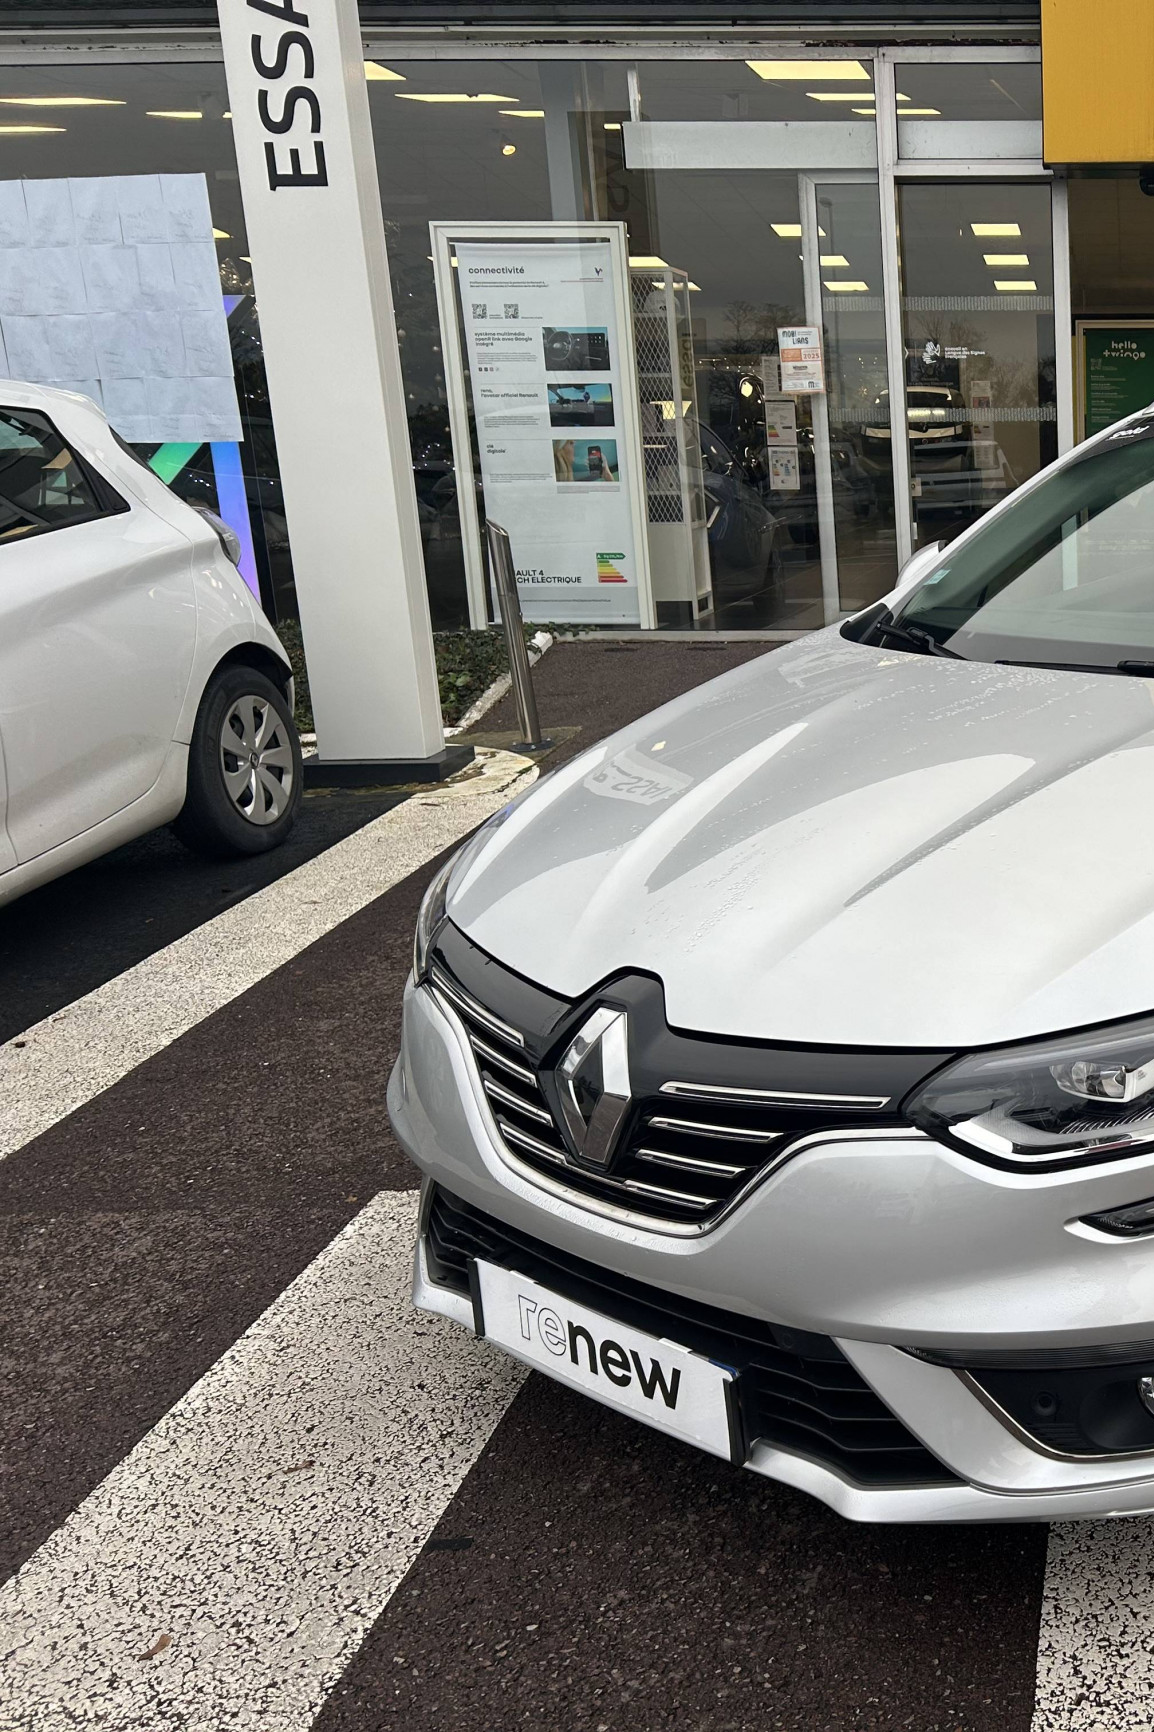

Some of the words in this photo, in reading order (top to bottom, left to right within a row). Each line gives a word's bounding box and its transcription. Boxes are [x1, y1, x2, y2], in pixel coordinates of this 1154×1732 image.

[468, 266, 525, 275] connectivité
[1111, 340, 1137, 349] hello
[1103, 349, 1146, 360] twingo
[518, 1294, 681, 1410] renew
